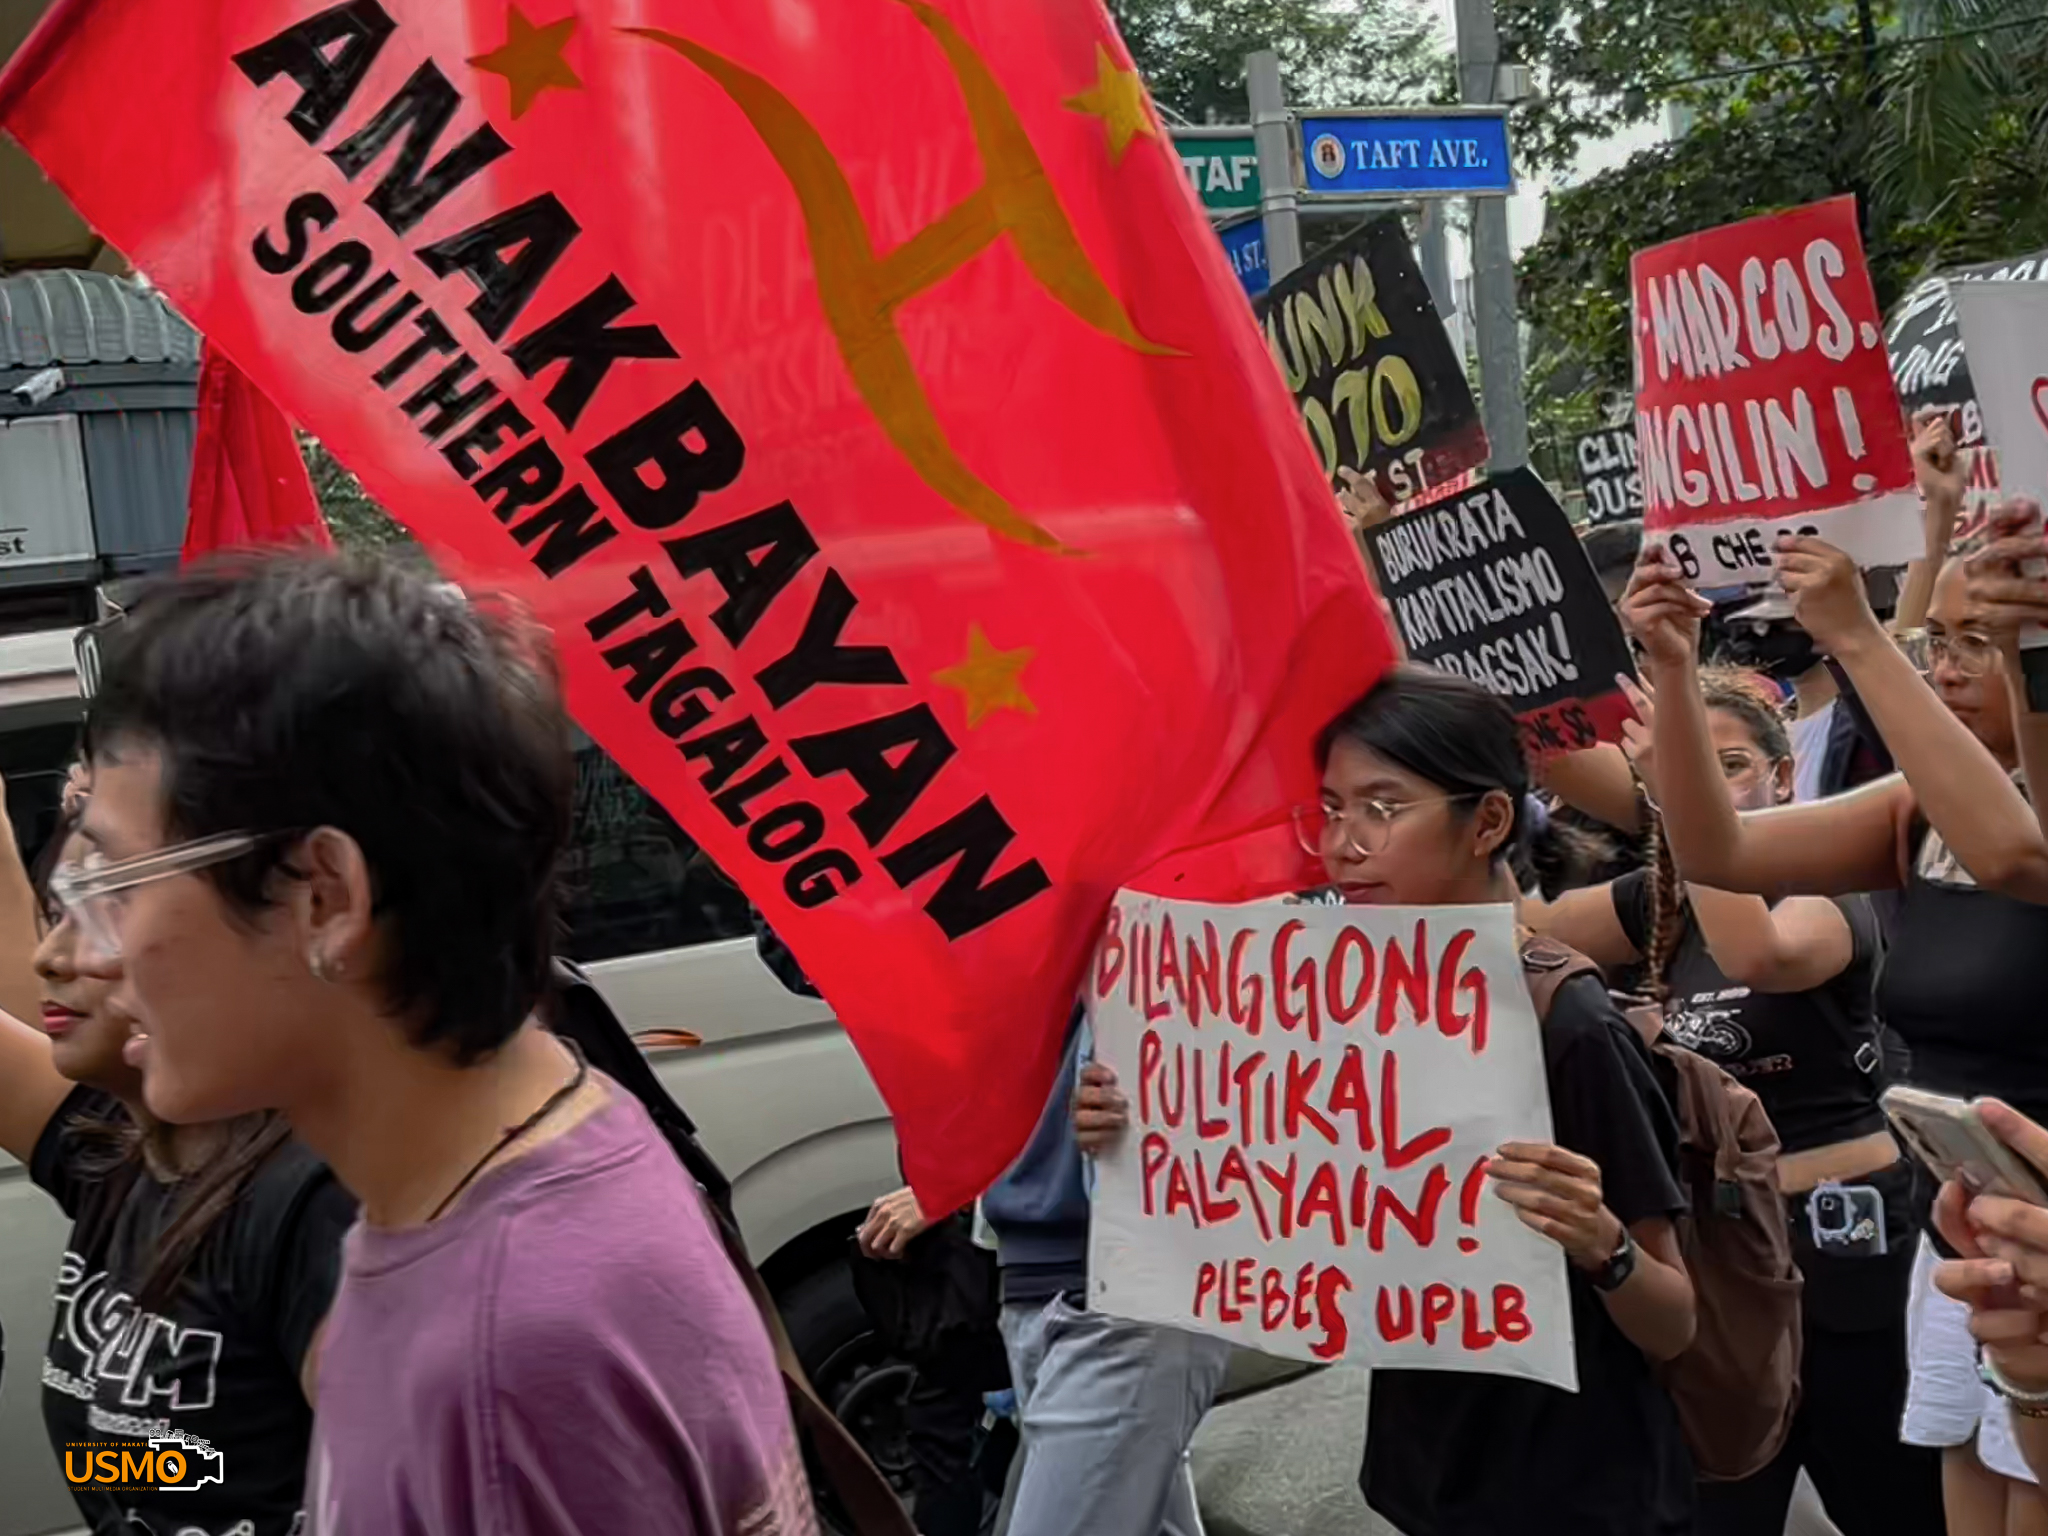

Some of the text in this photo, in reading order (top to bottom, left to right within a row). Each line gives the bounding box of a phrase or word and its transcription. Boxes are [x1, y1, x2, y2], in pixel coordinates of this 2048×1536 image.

[1182, 155, 1258, 192] TAF
[1351, 139, 1489, 170] TAFT AVE.
[231, 0, 1054, 943] ANAKBAYAN
[252, 192, 620, 579] SOUTHERN
[584, 564, 863, 910] TAGALOG
[1376, 488, 1527, 585] BURUKRATA
[1396, 546, 1565, 651] KAPITALISMO
[1097, 903, 1489, 1056] BILANGGONG
[1139, 1029, 1453, 1170] PULITIKAL
[1141, 1131, 1493, 1253] PALAYAIN!
[1193, 1257, 1534, 1361] PLEBES UPLB
